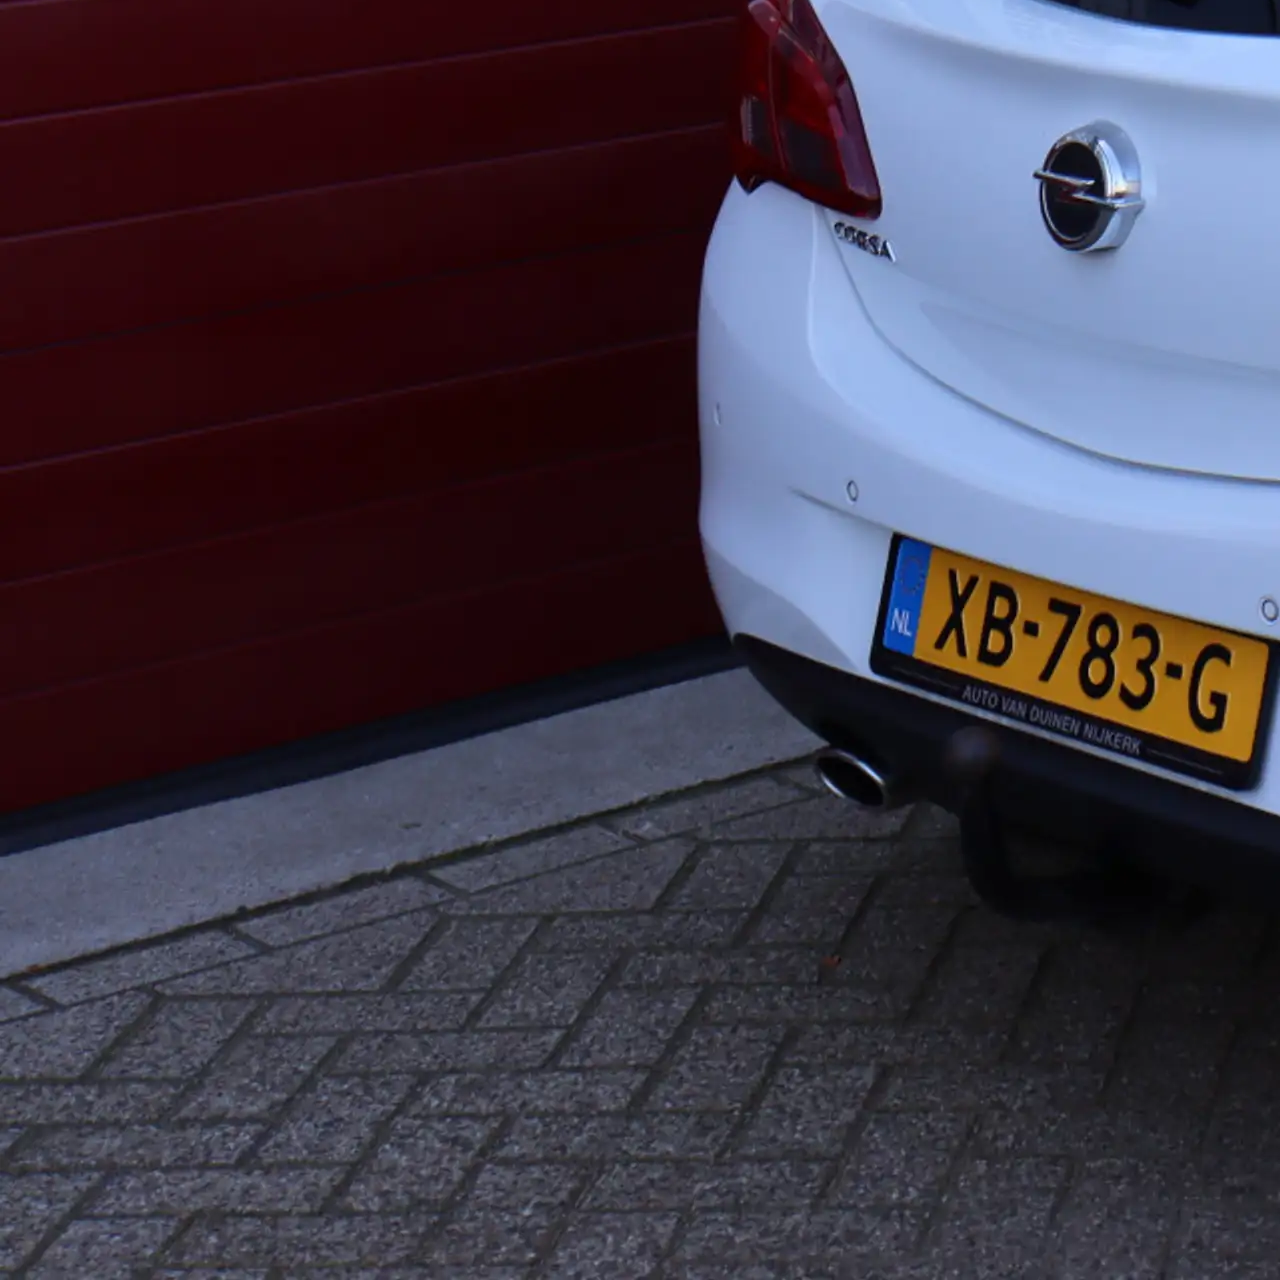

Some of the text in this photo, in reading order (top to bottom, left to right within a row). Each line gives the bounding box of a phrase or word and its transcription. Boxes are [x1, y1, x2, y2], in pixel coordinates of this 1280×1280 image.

[834, 221, 896, 262] CORSA
[890, 607, 912, 638] NL
[934, 567, 1232, 734] XB-783-G
[962, 684, 1142, 756] AUTO VAN DUINEN NIJKERK
